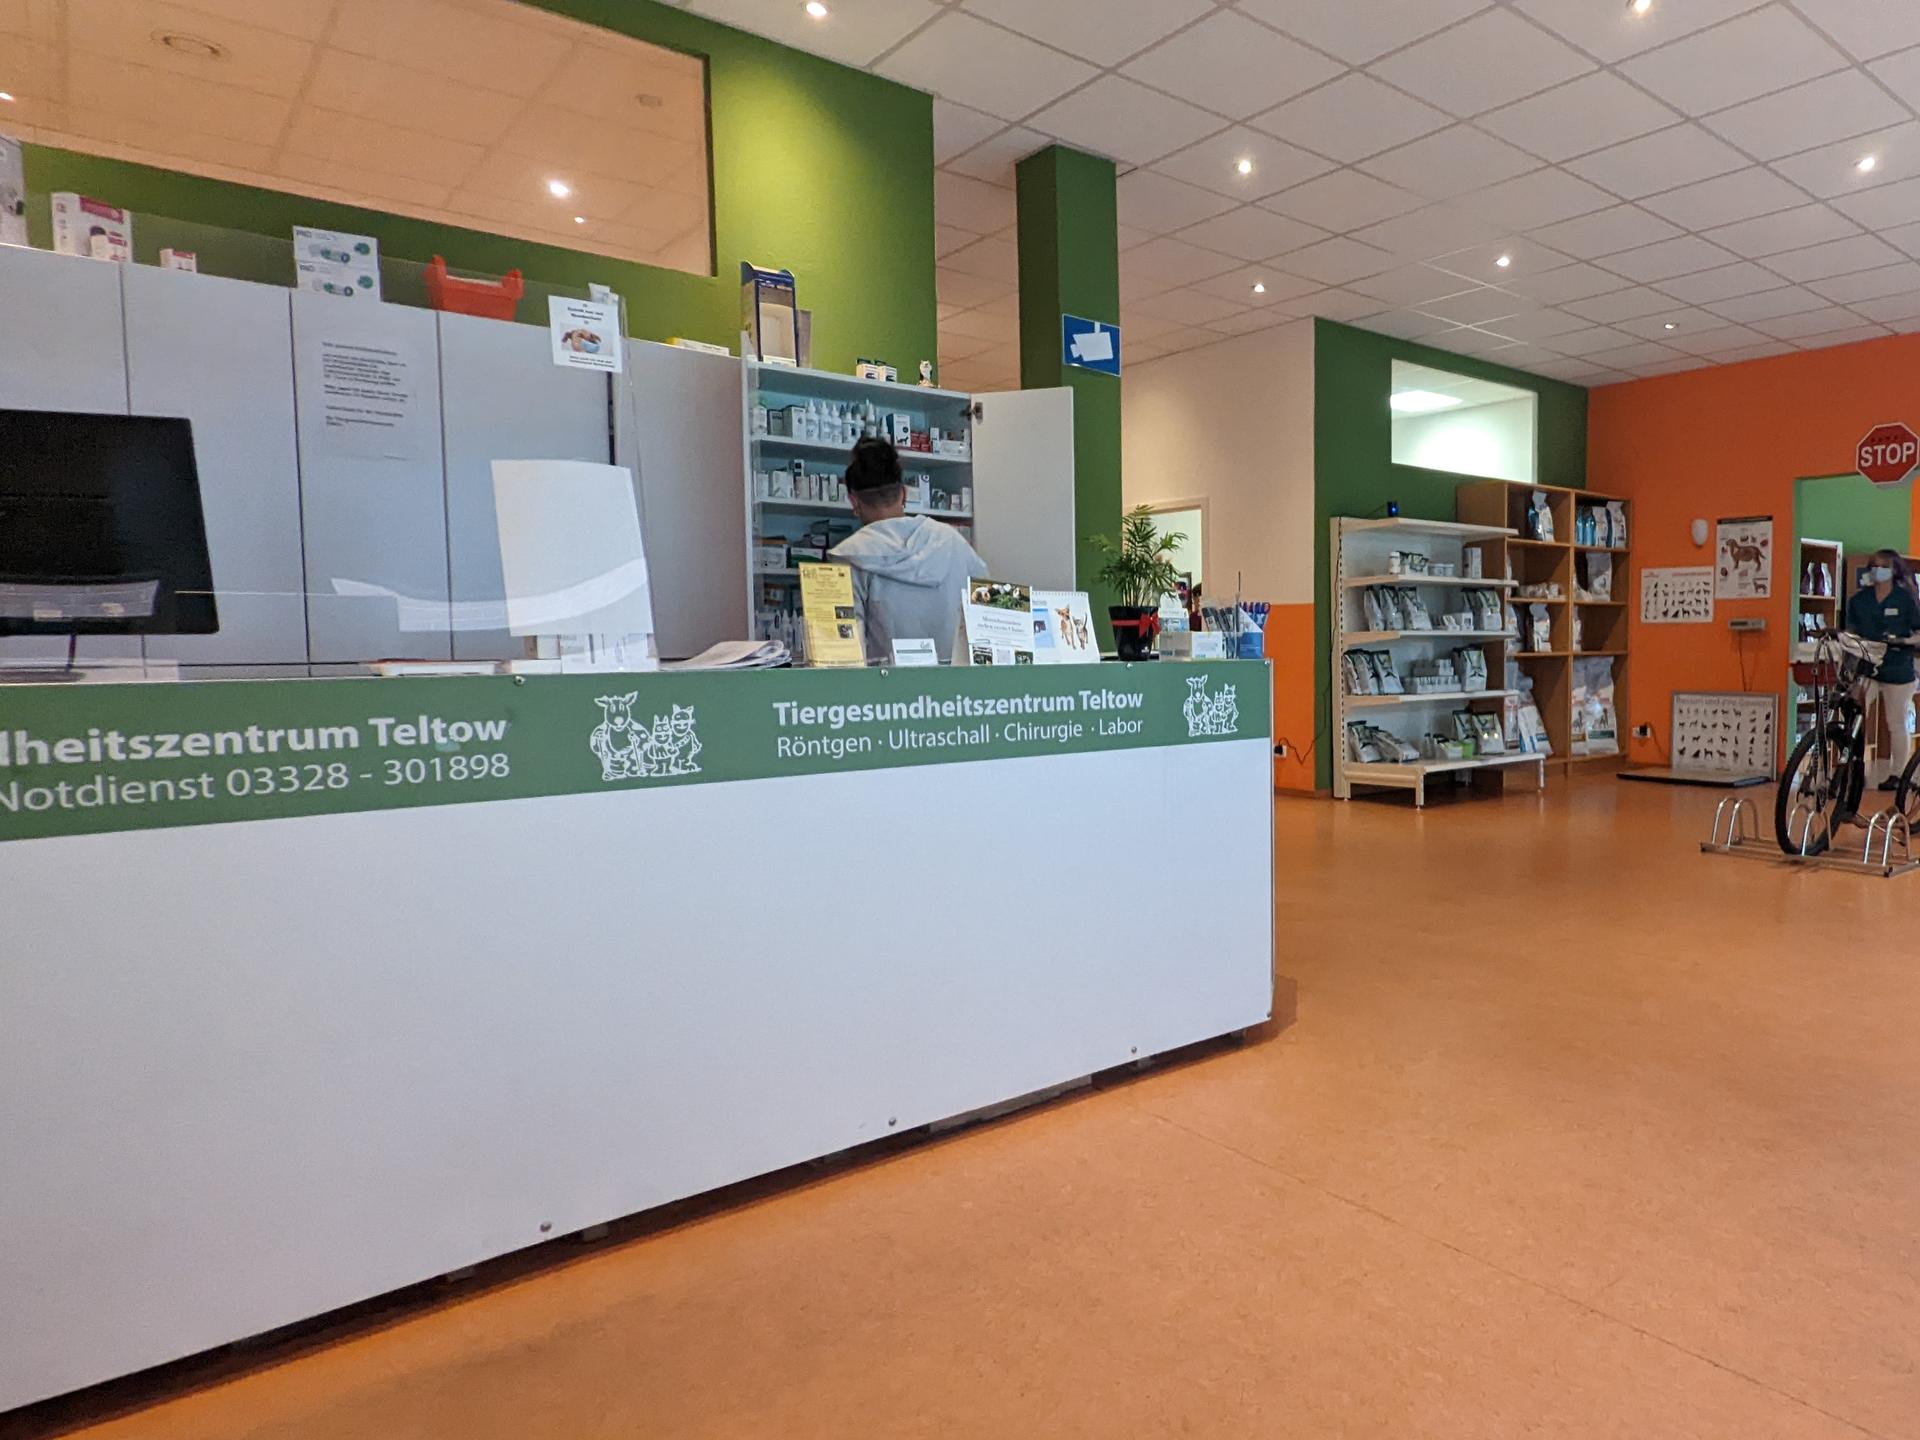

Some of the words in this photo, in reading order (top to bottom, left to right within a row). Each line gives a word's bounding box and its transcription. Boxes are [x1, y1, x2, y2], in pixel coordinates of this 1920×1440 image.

[1860, 442, 1915, 468] STOP
[772, 692, 1075, 731] Tiergesundheitszentrum
[1078, 688, 1144, 712] Teltow
[367, 715, 508, 749] Teltow
[776, 735, 872, 760] Röntgen
[888, 724, 990, 750] Ultraschall
[1004, 722, 1084, 744] Chirurgie
[1099, 717, 1144, 736] Labor
[226, 763, 350, 797] 03328
[383, 753, 511, 786] 301898
